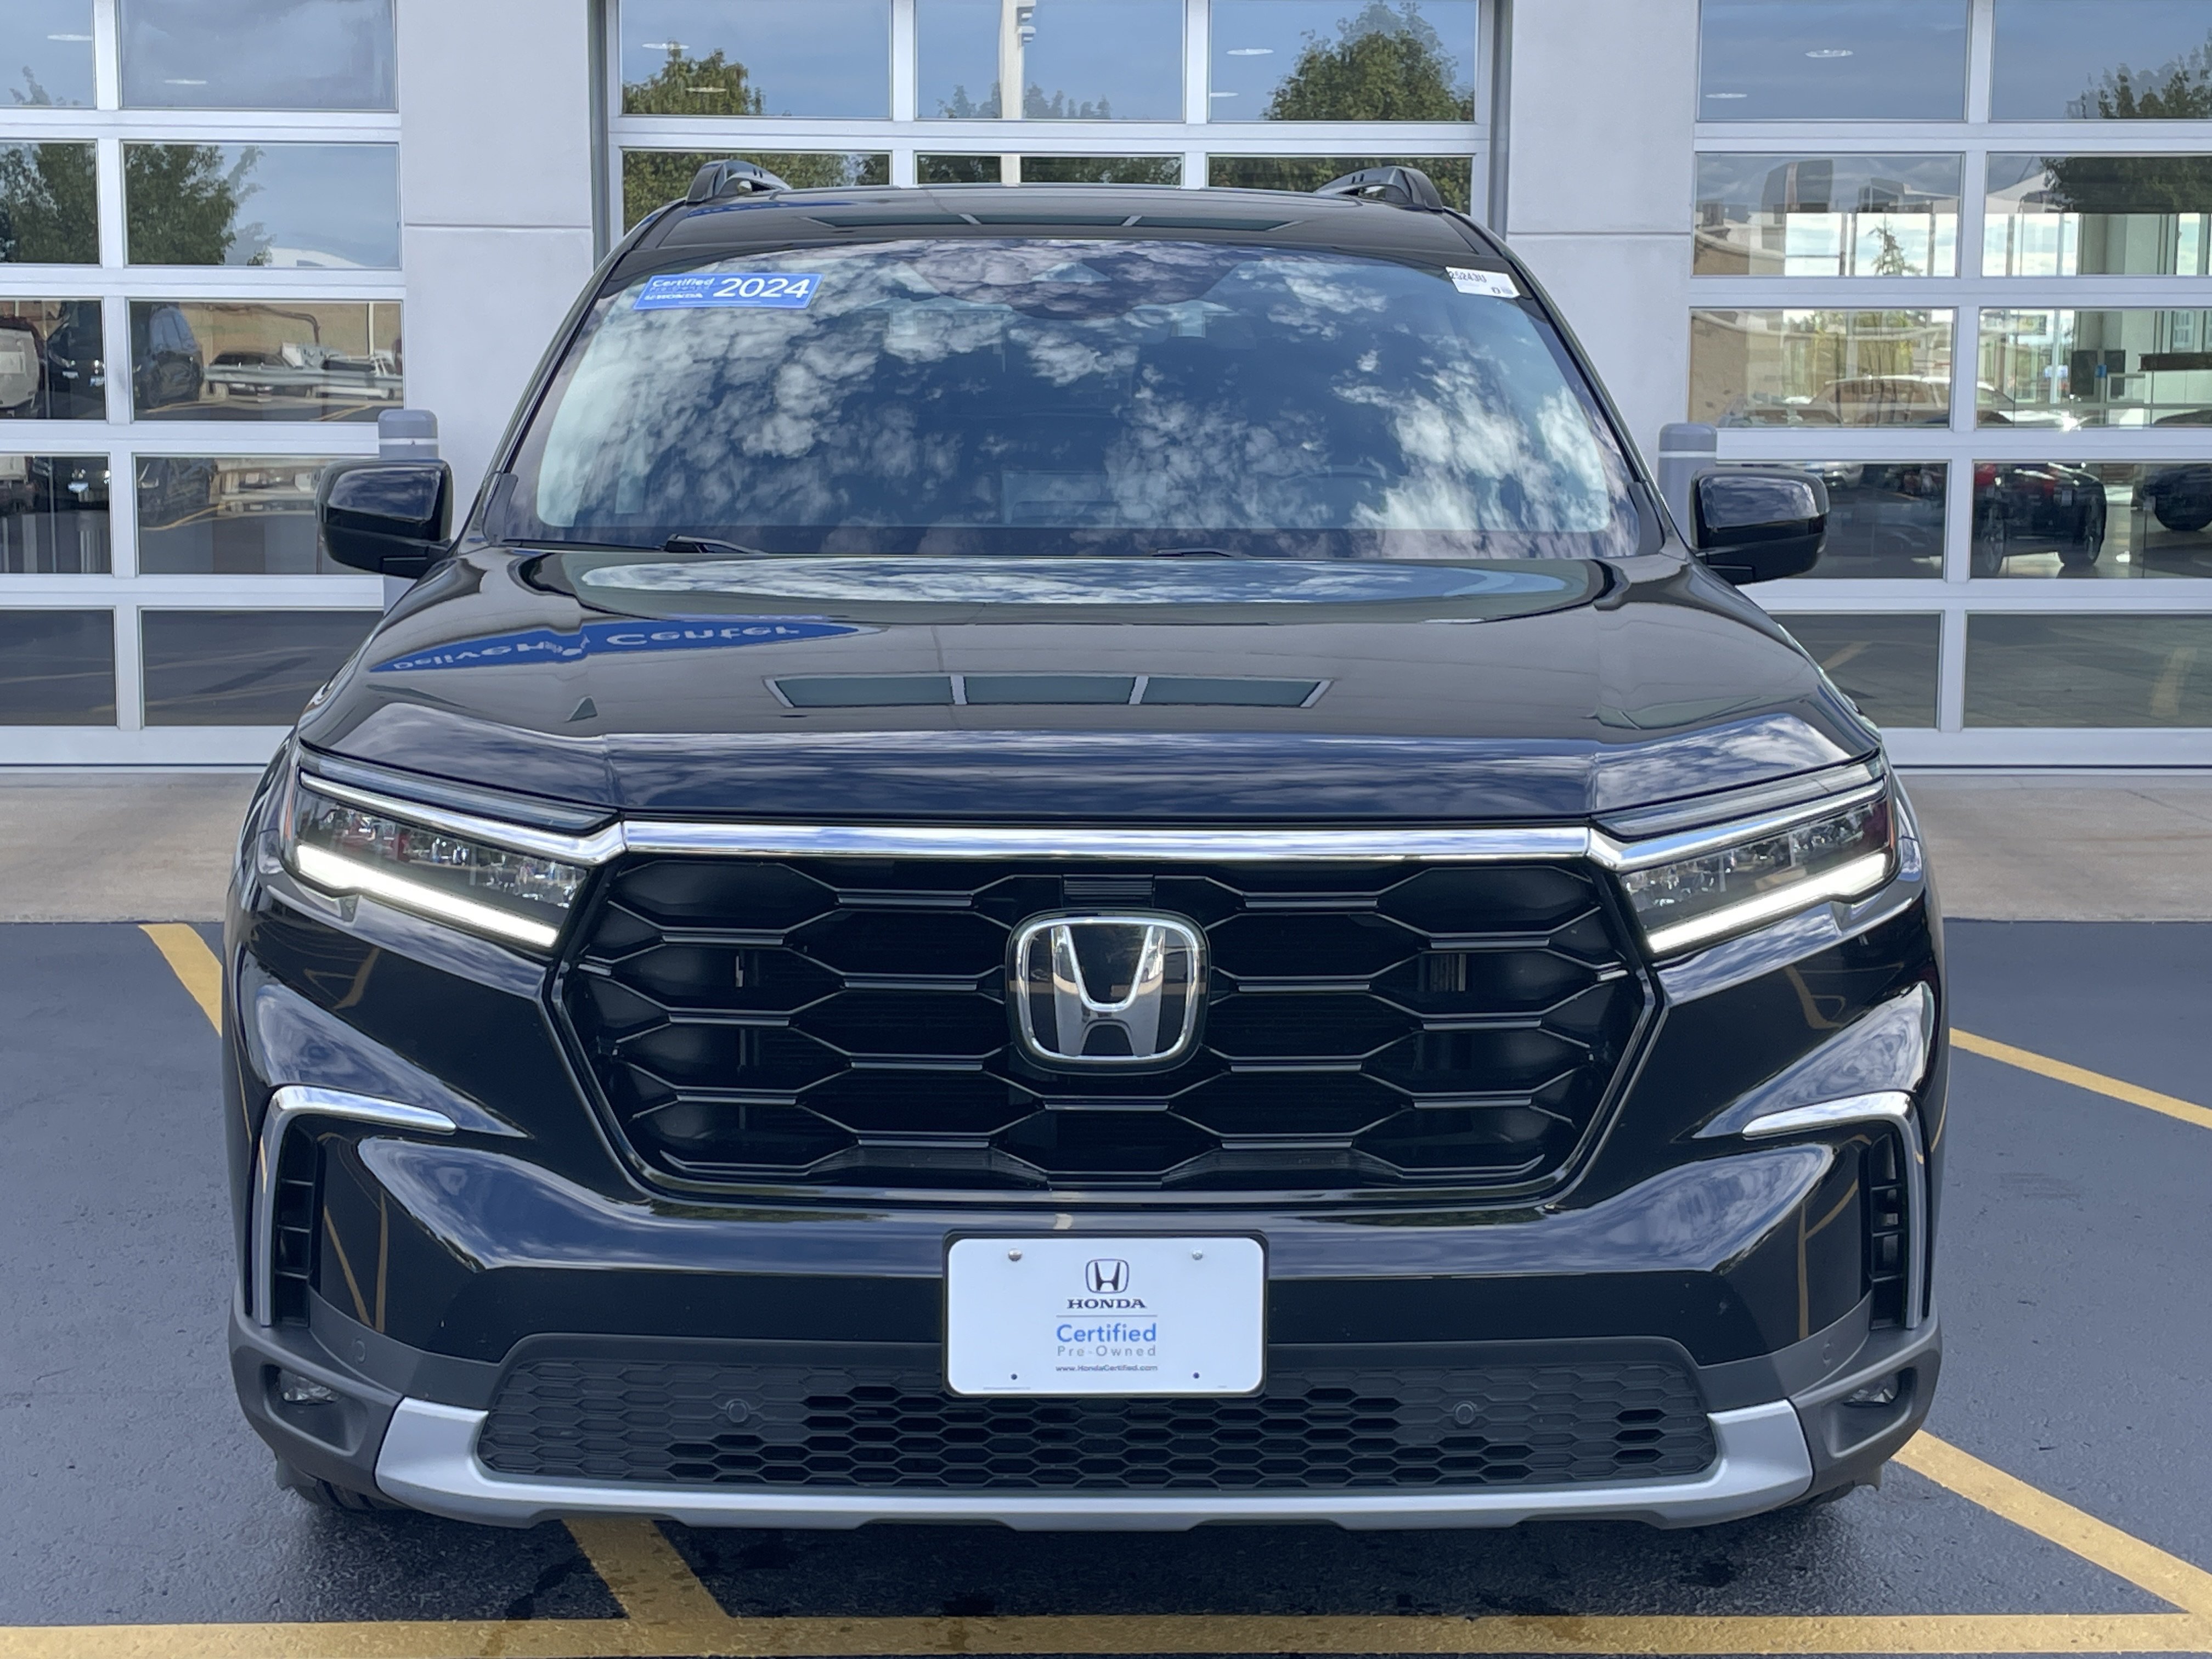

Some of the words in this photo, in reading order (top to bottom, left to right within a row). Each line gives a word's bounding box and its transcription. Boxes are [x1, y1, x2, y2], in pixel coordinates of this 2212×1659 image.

[652, 277, 715, 287] Certified
[713, 278, 810, 298] 2024
[1067, 1299, 1146, 1309] HONDA
[1056, 1322, 1157, 1342] Certified
[1057, 1345, 1156, 1357] Pre-Owned
